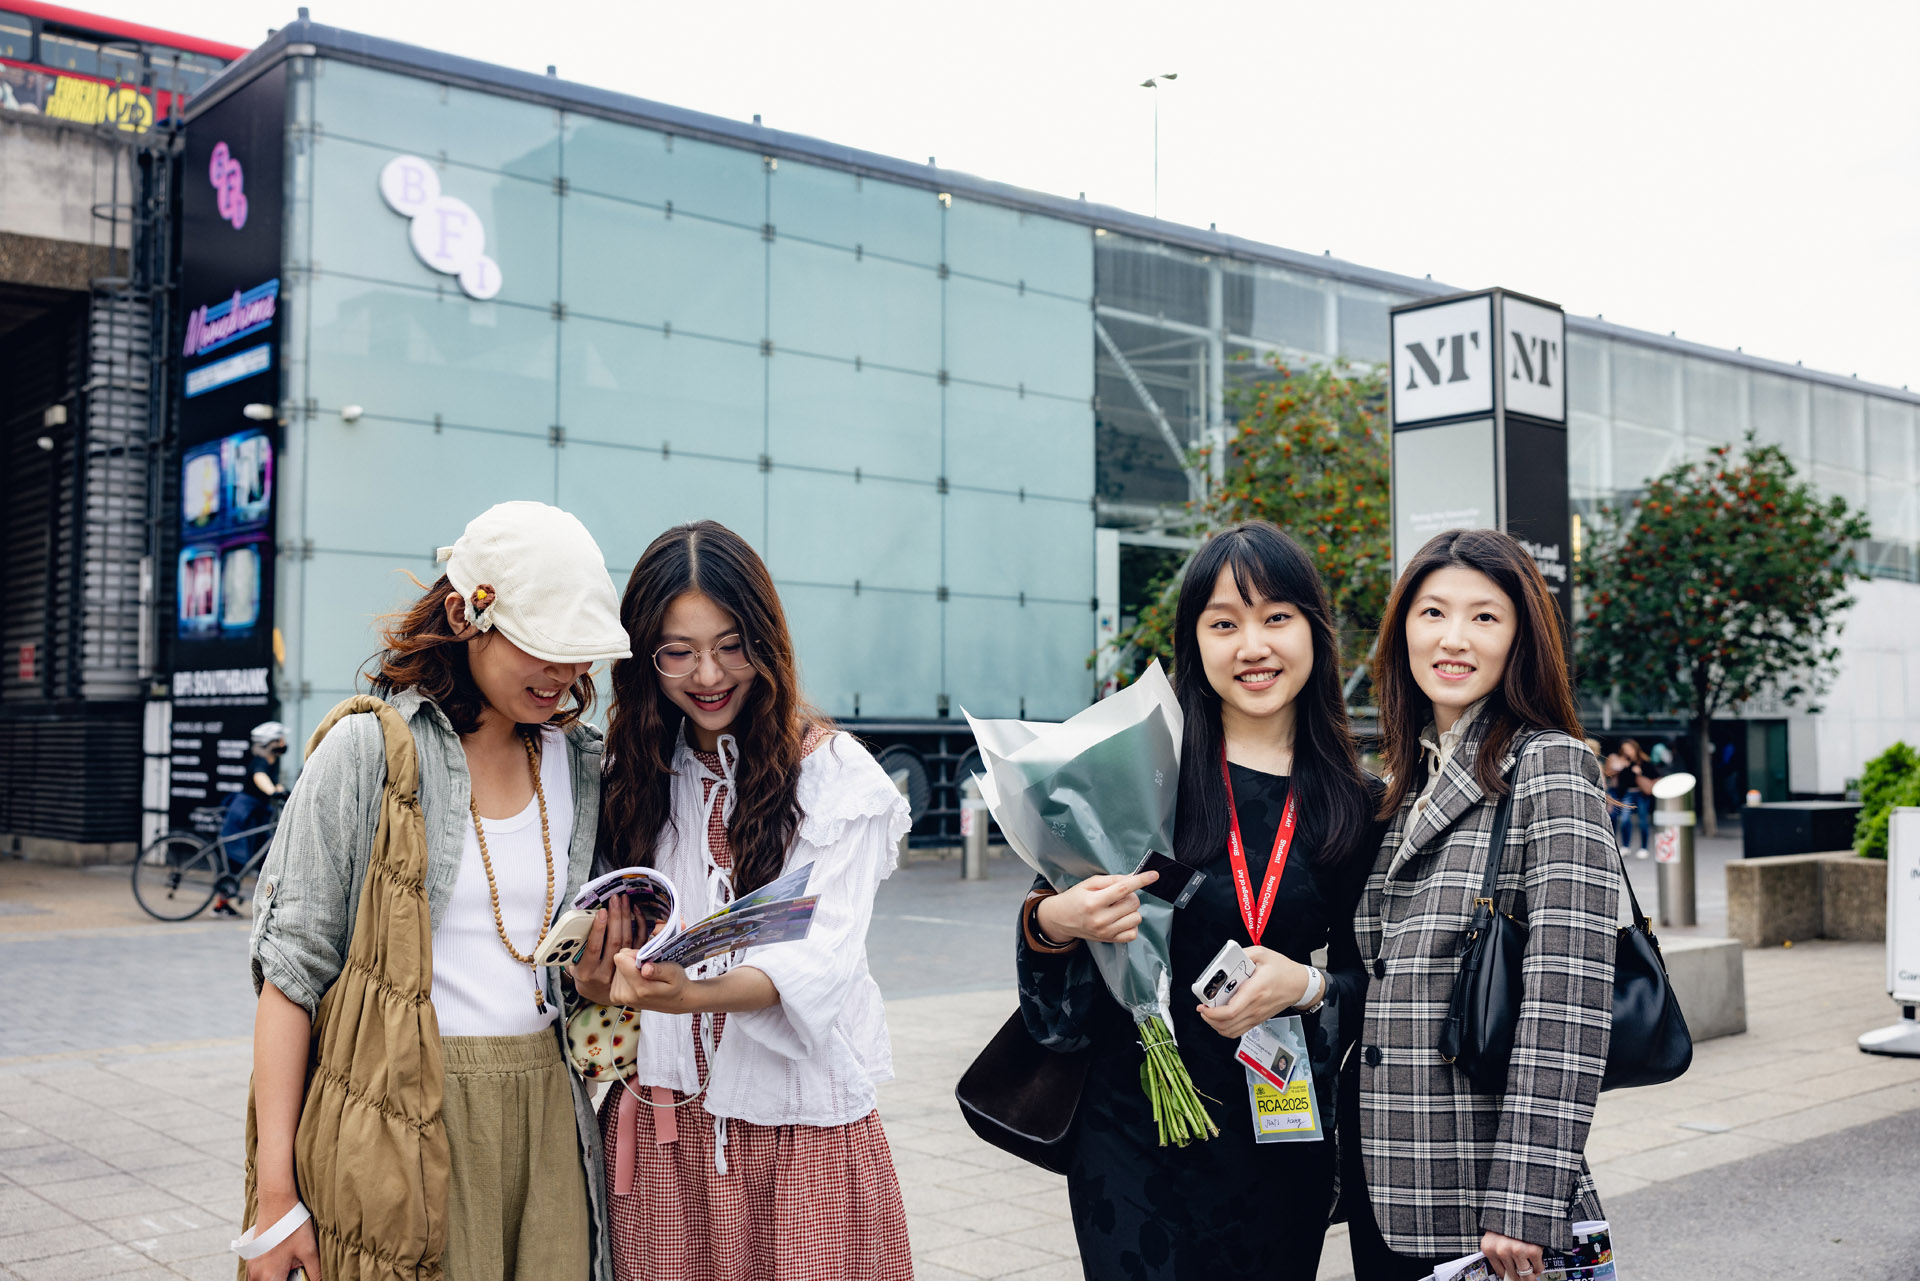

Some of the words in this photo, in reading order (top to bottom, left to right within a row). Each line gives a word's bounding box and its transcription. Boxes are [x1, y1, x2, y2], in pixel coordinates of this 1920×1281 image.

[394, 161, 492, 293] BFI
[1405, 331, 1479, 390] NT
[1511, 331, 1558, 388] NT
[194, 668, 269, 696] SOUTHBANK
[1230, 831, 1239, 856] Student
[1275, 839, 1287, 864] Student
[1266, 875, 1276, 893] Royal
[1242, 885, 1251, 911] College
[1259, 892, 1271, 917] College
[1246, 910, 1254, 930] Royal
[667, 932, 723, 961] NIMATION
[1258, 1097, 1309, 1113] RCA2025
